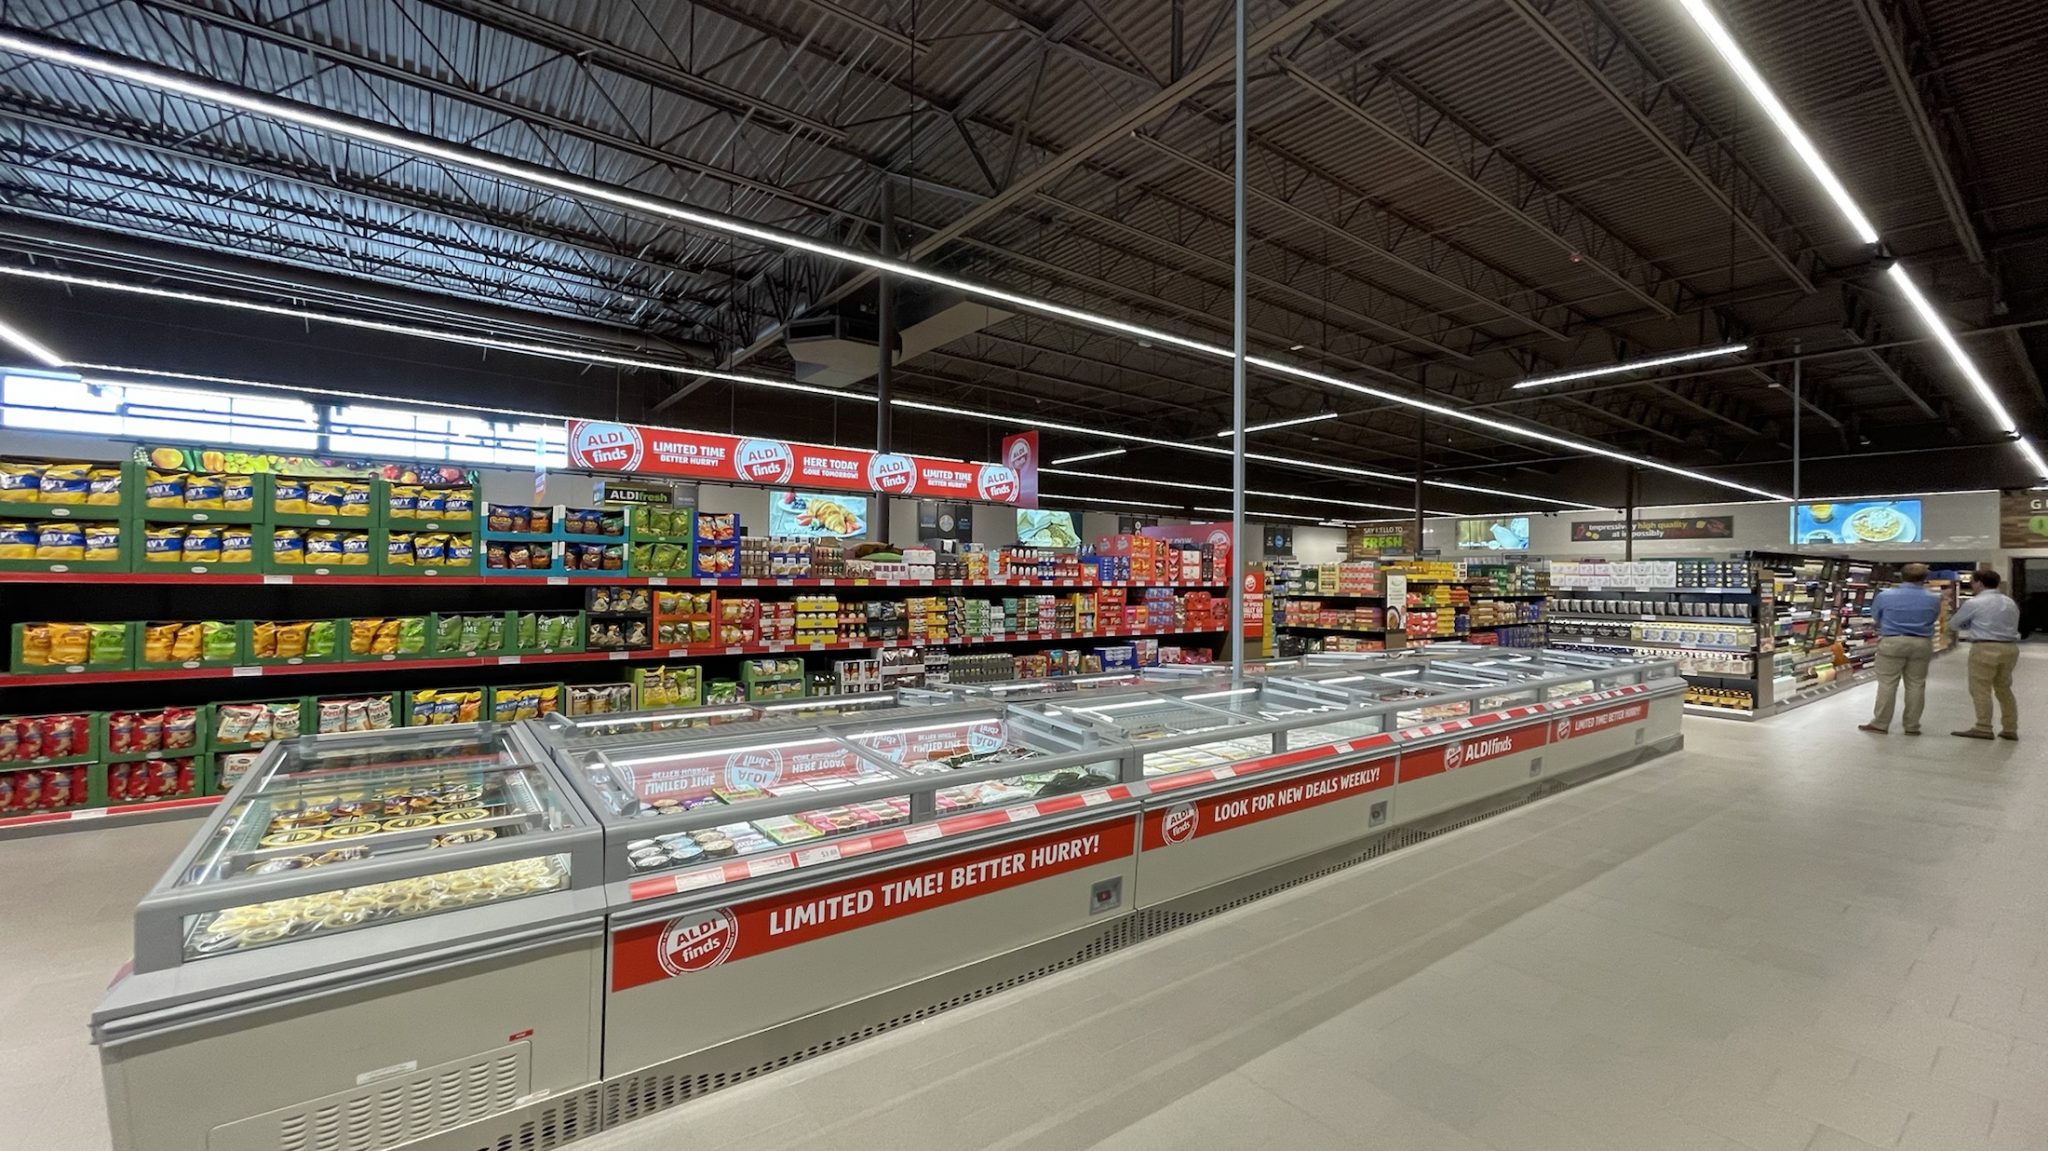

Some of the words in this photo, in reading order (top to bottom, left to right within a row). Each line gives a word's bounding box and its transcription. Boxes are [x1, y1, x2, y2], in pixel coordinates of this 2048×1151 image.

[587, 432, 624, 446] ALDI
[653, 441, 698, 455] LIMITED
[700, 446, 725, 457] TIME
[748, 448, 778, 462] ALDI
[592, 449, 627, 463] finds
[660, 454, 689, 464] BETTER
[690, 457, 719, 466] HURRY!
[752, 463, 781, 476] finds
[803, 457, 827, 468] HERE
[830, 459, 859, 470] TODAY
[879, 462, 903, 474] ALDI
[803, 468, 820, 476] GONE
[821, 470, 858, 479] TOMORROW!
[923, 469, 953, 480] LIMITED
[955, 471, 972, 481] TIME
[987, 472, 1008, 483] ALDI
[882, 475, 906, 488] finds
[927, 479, 947, 487] BETTER
[610, 490, 668, 502] ALDIfresh
[990, 484, 1010, 496] finds
[1637, 521, 1656, 531] high
[1657, 520, 1687, 530] quality
[1363, 536, 1402, 548] FRESH
[1465, 736, 1512, 761] ALDIfinds
[1215, 798, 1249, 822] LOOK
[1251, 793, 1275, 813] FOR
[1278, 786, 1303, 807] NEW
[1305, 777, 1338, 799] DEALS
[1340, 767, 1380, 790] WEEKLY!
[1170, 808, 1190, 825] ALDI
[1172, 820, 1191, 836] finds
[769, 889, 874, 936] LIMITED
[881, 871, 944, 907] TIME!
[951, 852, 1026, 890] BETTER
[1031, 834, 1099, 869] HURRY!
[676, 918, 718, 947] ALDI
[682, 938, 720, 963] finds
